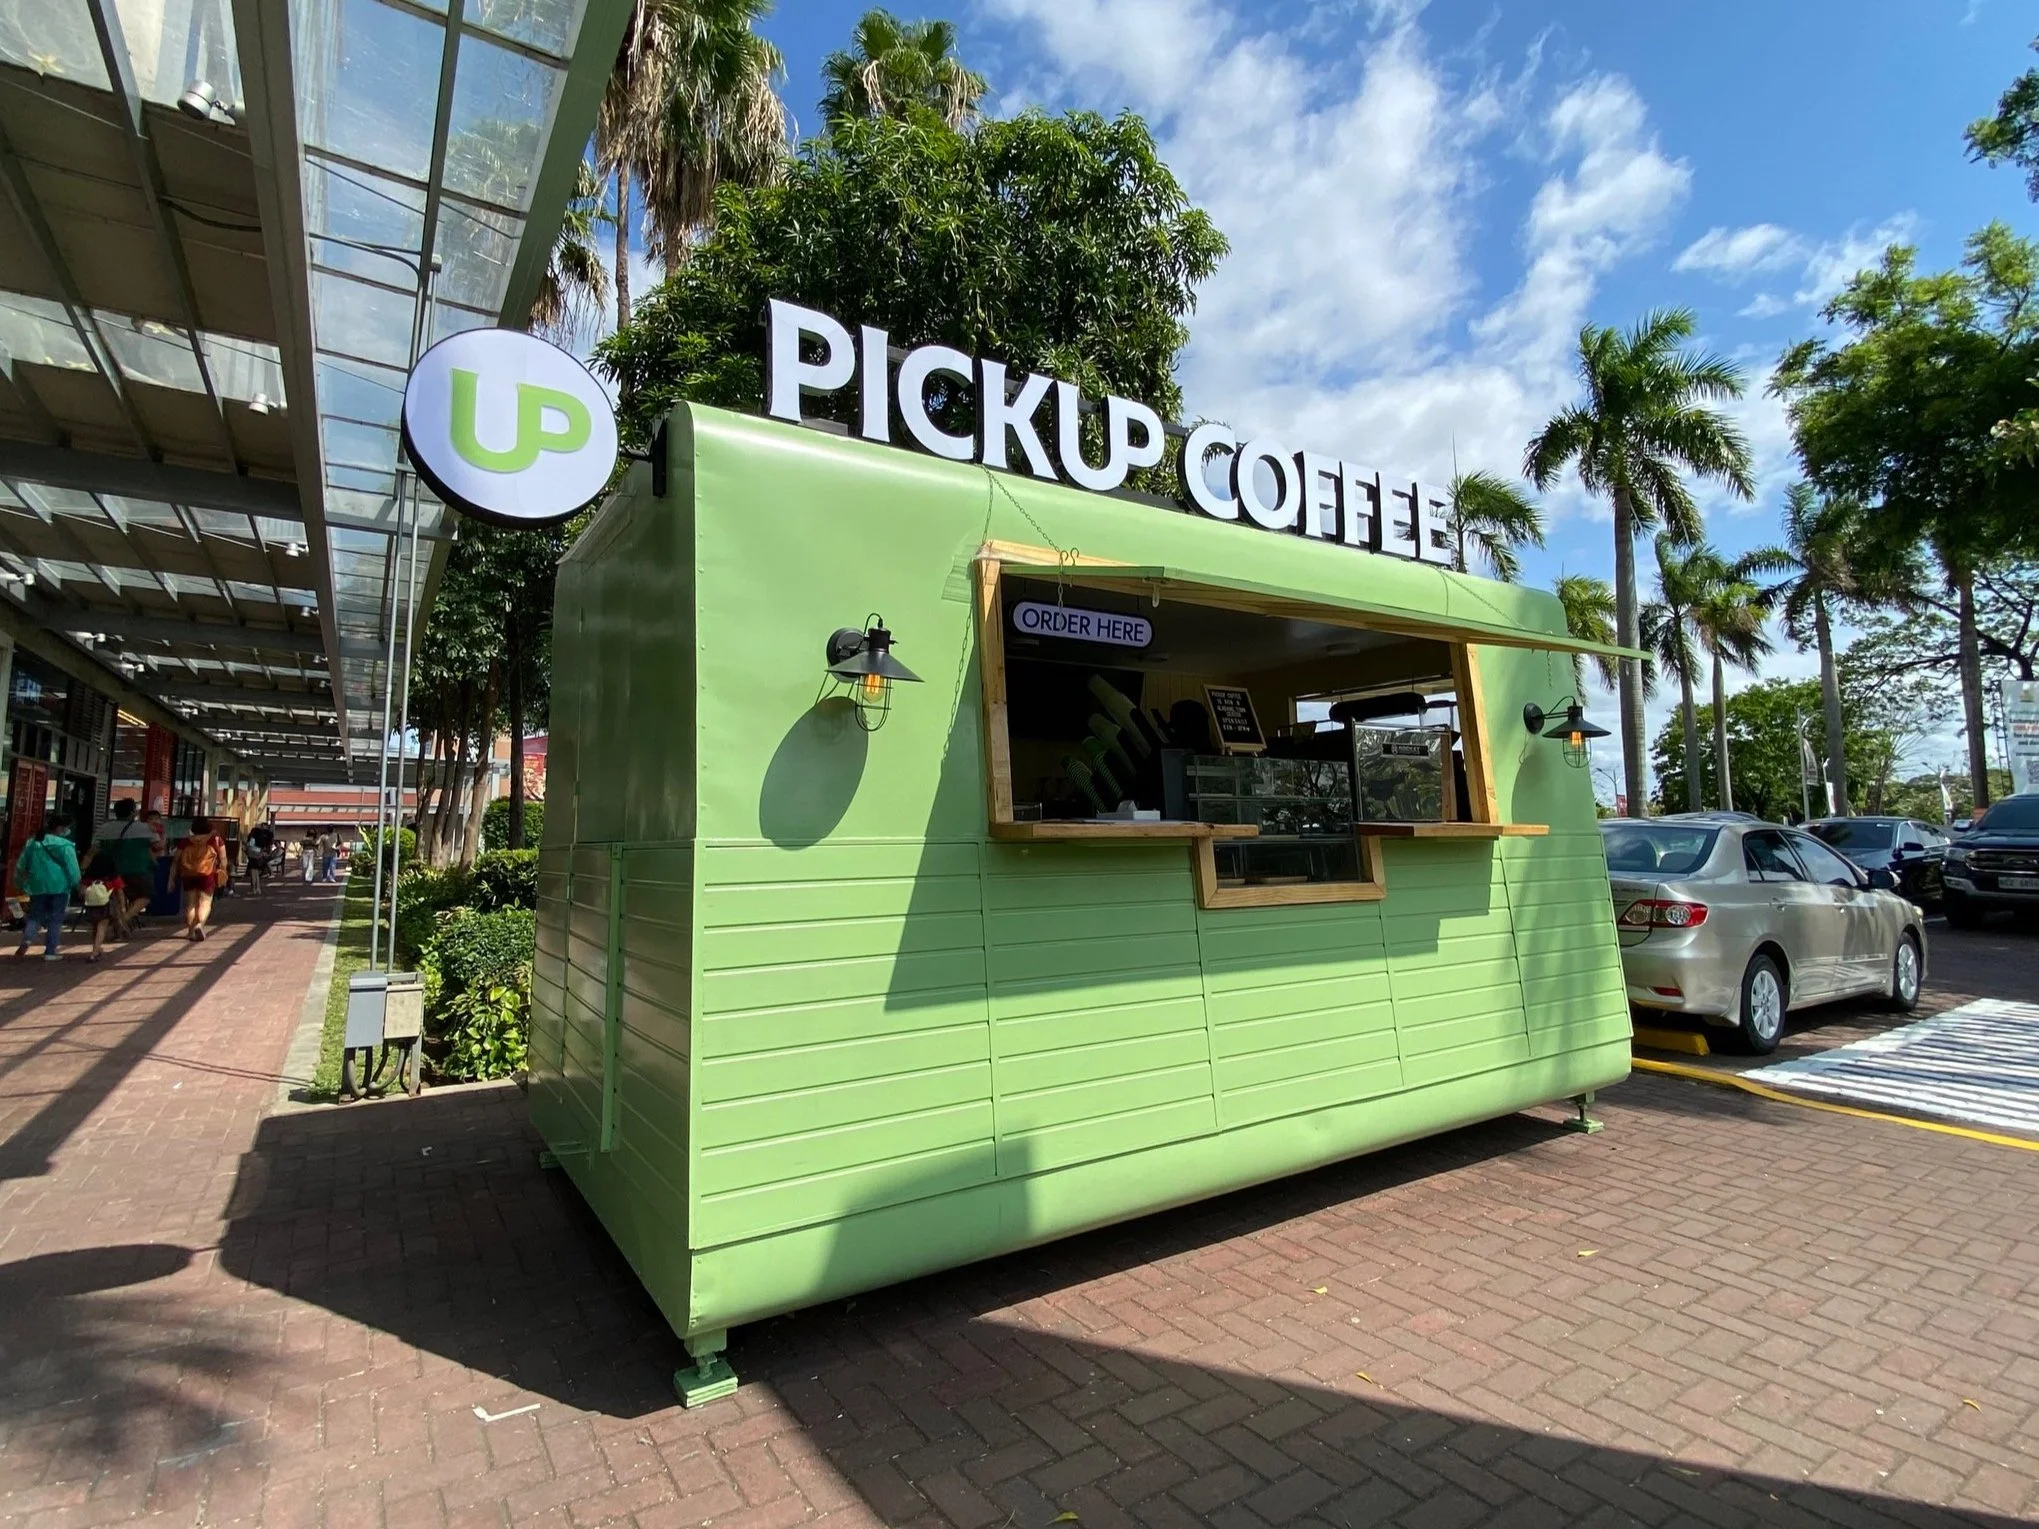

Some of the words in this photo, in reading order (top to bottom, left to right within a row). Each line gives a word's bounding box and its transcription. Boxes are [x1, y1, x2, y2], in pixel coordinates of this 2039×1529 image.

[450, 367, 592, 473] UP
[767, 297, 1165, 491] PICKUP
[1180, 422, 1452, 566] COFFEE
[1021, 608, 1091, 636] ORDER
[1097, 618, 1145, 642] HERE
